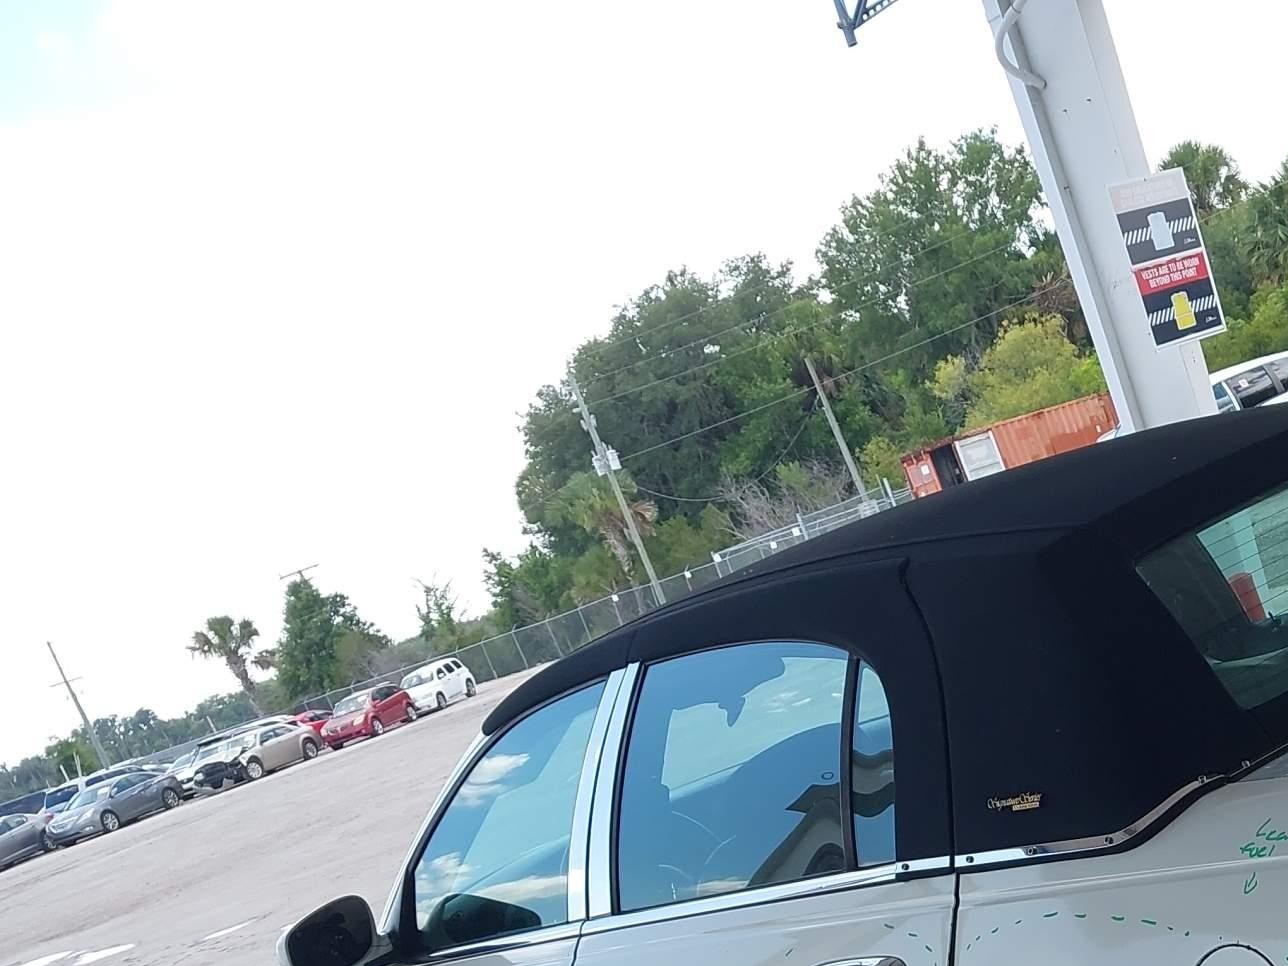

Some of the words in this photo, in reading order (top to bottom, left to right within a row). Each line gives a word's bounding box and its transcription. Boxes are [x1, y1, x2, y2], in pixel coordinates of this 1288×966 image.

[1141, 268, 1159, 280] VESTS
[1159, 265, 1169, 275] ARE
[1168, 263, 1177, 272] TO
[1176, 261, 1184, 271] BE
[1183, 256, 1200, 269] WORN
[1148, 275, 1171, 289] BEYOND
[1170, 271, 1183, 282] THIS
[1182, 267, 1198, 279] POINT
